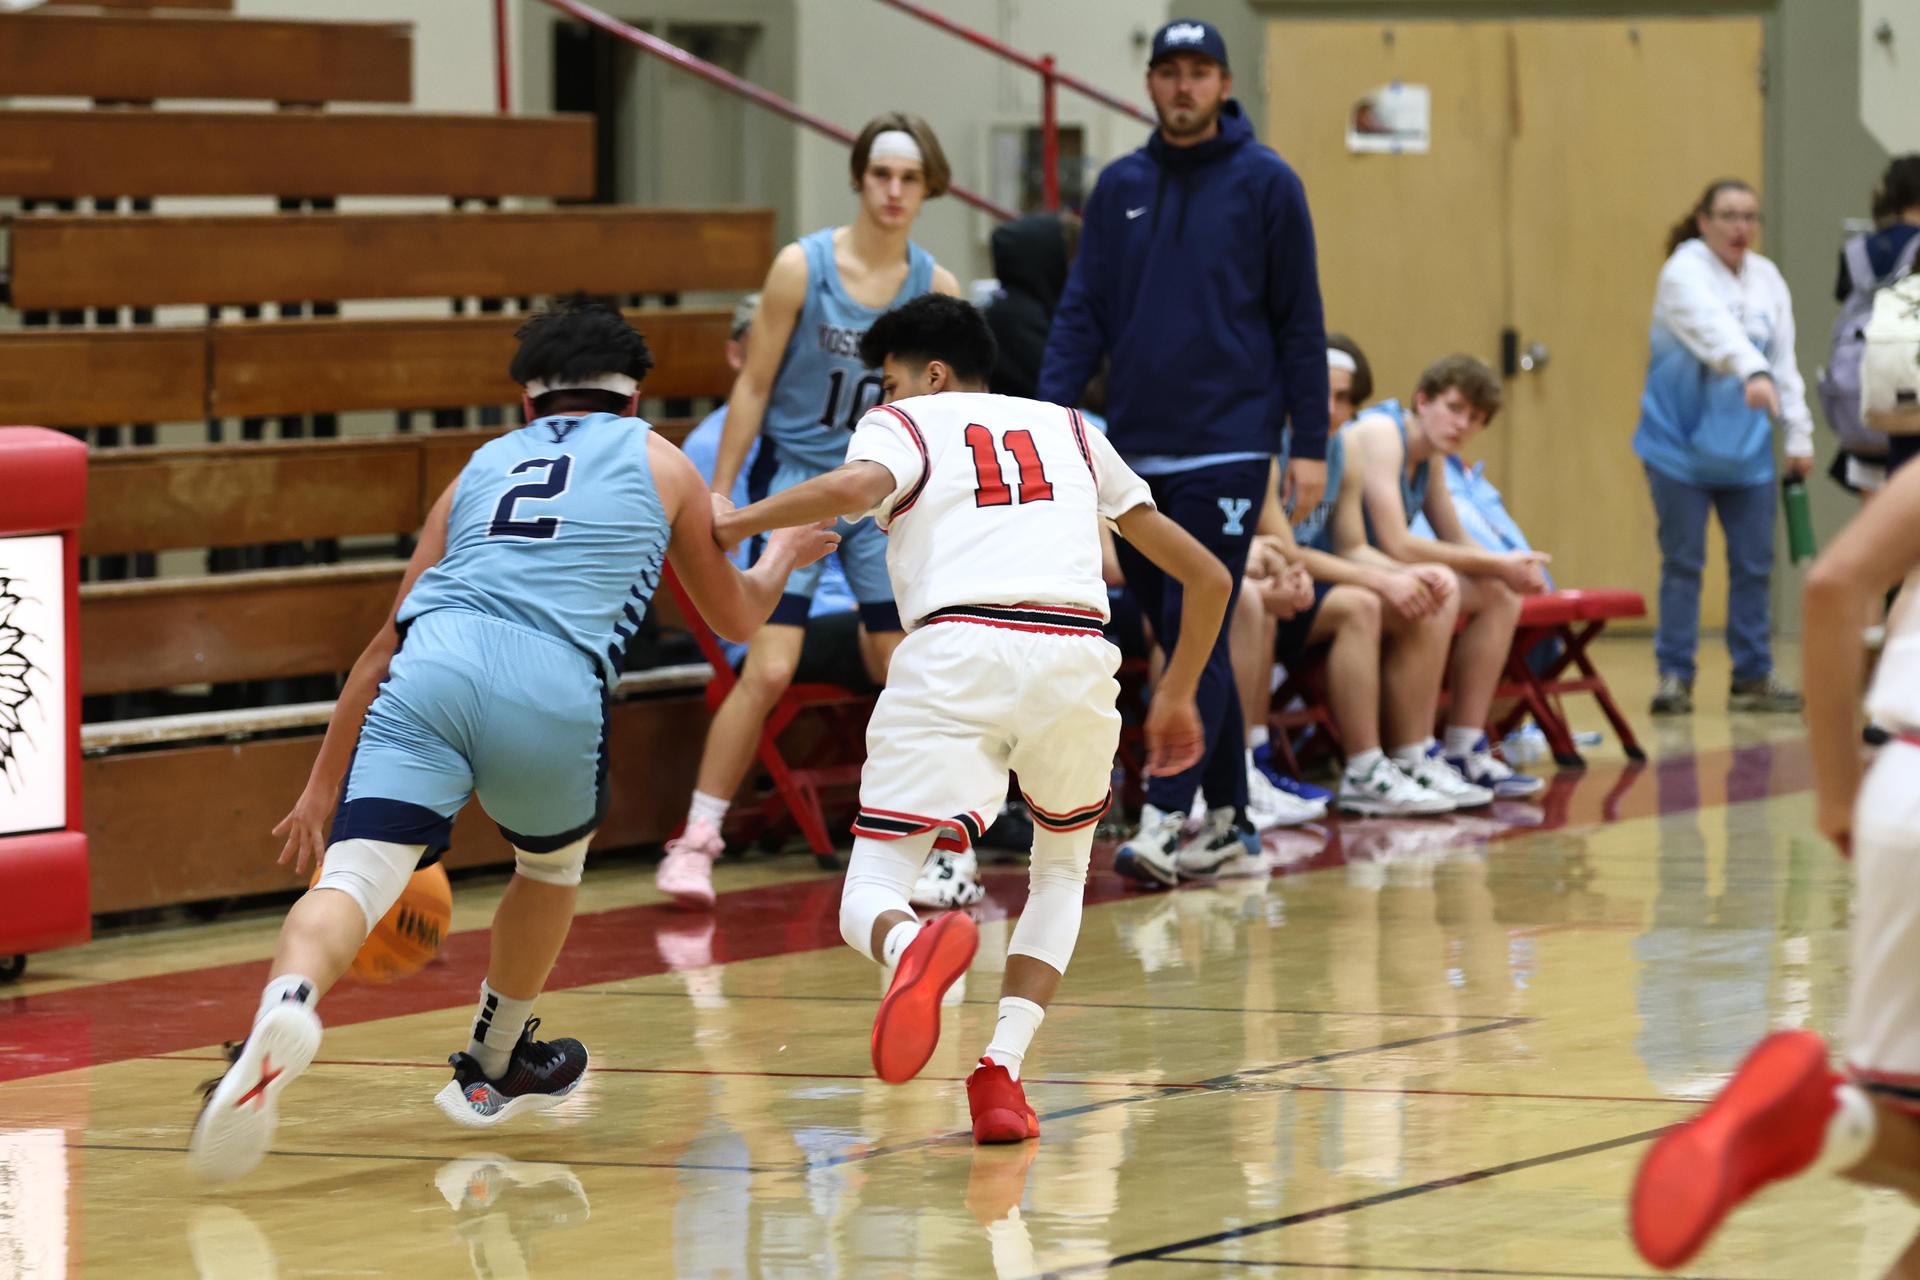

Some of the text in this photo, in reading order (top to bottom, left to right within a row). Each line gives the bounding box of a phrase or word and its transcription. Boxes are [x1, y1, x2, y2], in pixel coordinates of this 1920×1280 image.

[818, 367, 885, 431] 10
[544, 420, 579, 443] Y
[486, 453, 575, 540] 2
[964, 423, 1054, 508] 11
[1217, 497, 1252, 536] Y
